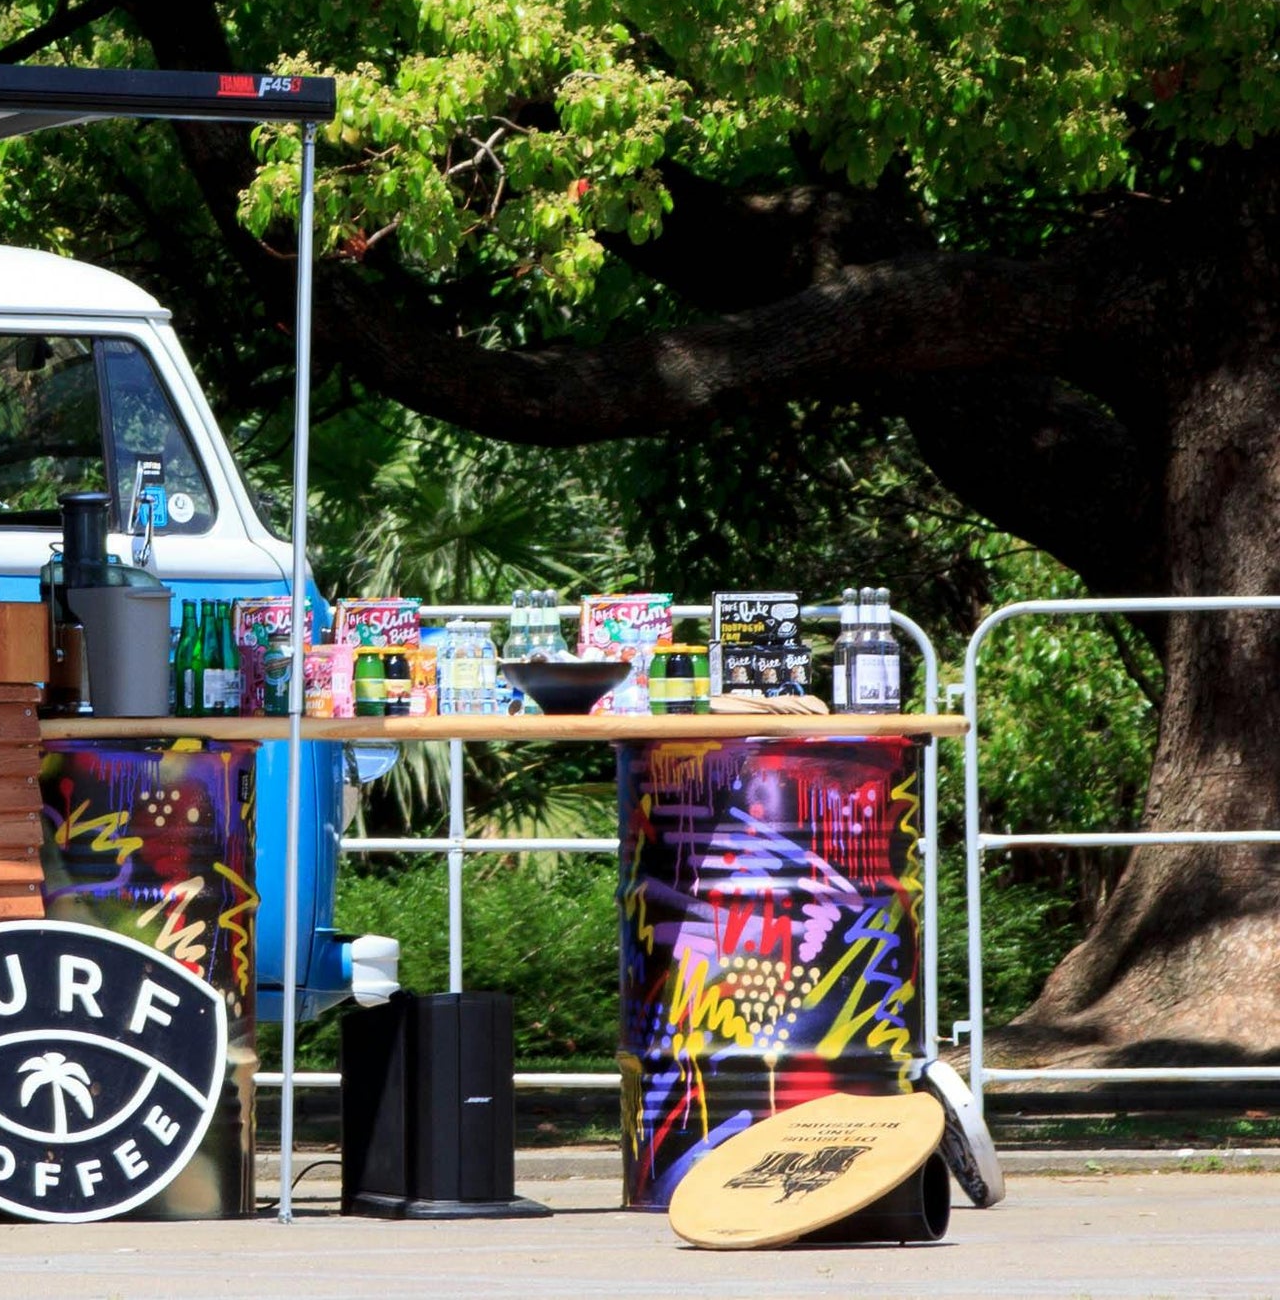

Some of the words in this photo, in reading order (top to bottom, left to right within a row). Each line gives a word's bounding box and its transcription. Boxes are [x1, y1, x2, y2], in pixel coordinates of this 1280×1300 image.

[265, 608, 293, 634] Sli
[369, 609, 416, 635] Slim
[617, 604, 668, 630] Slim
[389, 627, 419, 644] Bite
